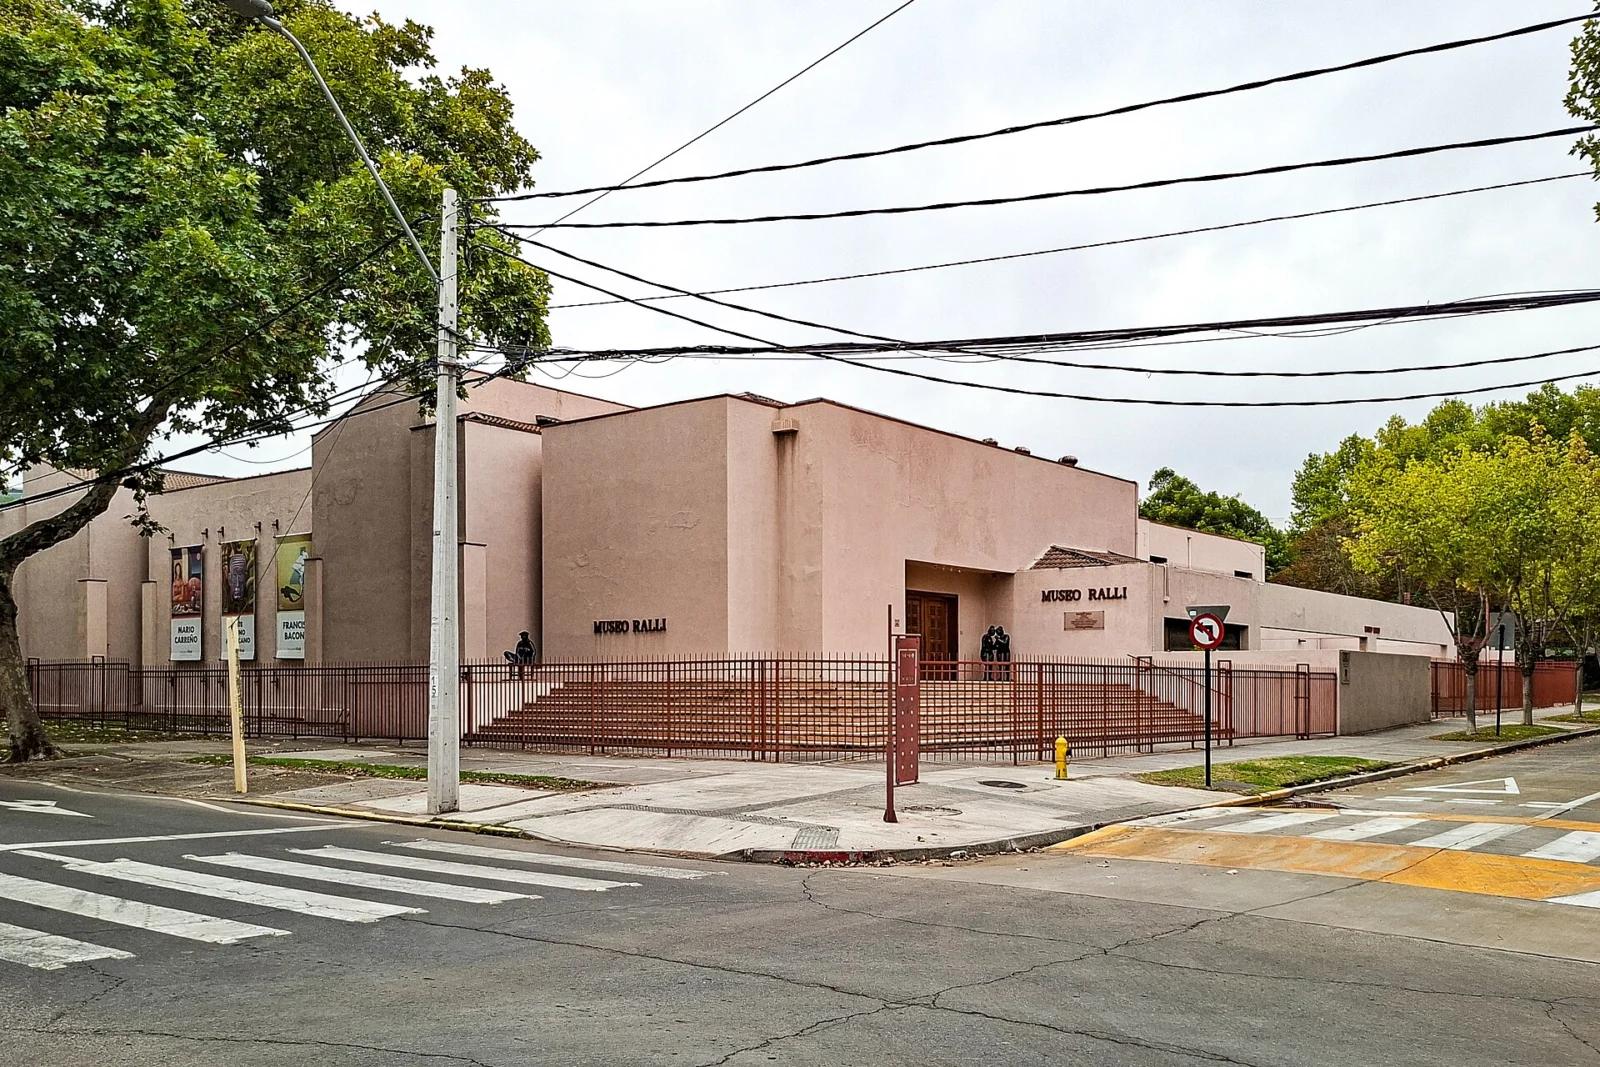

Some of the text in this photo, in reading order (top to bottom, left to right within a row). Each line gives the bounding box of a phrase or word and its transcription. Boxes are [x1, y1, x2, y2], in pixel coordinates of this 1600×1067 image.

[1041, 586, 1127, 603] MUSEO RALLI
[177, 626, 195, 634] MARIO
[593, 618, 667, 634] MUSEO RALLI
[174, 634, 198, 644] CARREÑO
[284, 631, 305, 641] BACON
